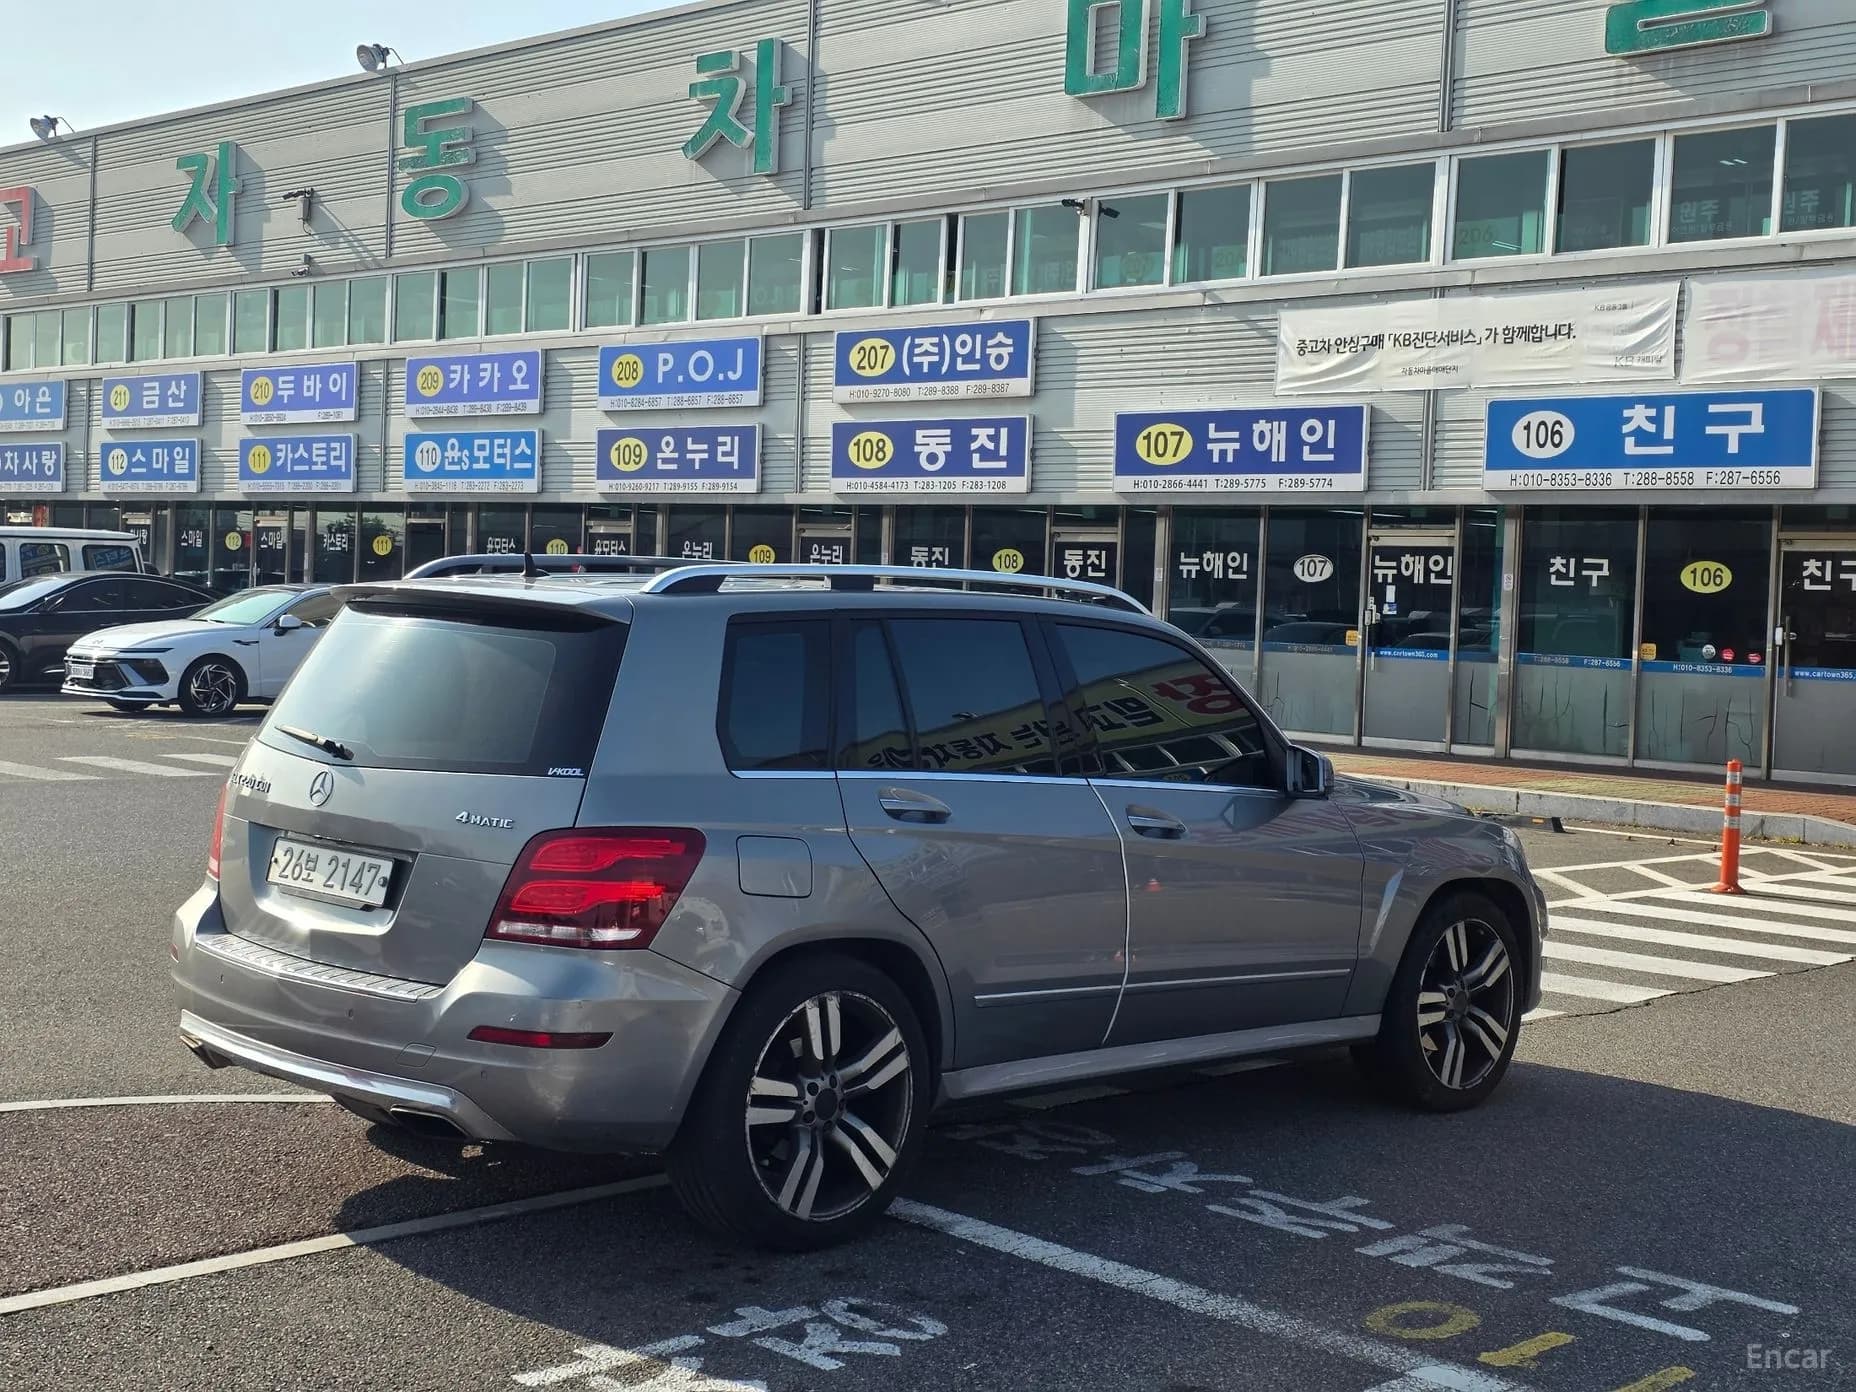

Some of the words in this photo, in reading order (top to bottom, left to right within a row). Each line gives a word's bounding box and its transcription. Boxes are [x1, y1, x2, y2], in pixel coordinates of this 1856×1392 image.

[1296, 338, 1332, 356] 중고차
[1335, 333, 1384, 354] 안심구매
[1485, 327, 1498, 344] 가
[1503, 322, 1576, 344] 함께합니다.
[617, 361, 638, 381] 208
[657, 348, 743, 383] P.O.J
[856, 344, 890, 370] 207
[902, 332, 1014, 376] (주)인승
[254, 382, 269, 400] 210
[277, 372, 347, 404] 두바이
[420, 372, 439, 390] 209
[449, 359, 530, 394] 카카오
[114, 389, 128, 403] 211
[142, 379, 187, 409] 금산
[849, 388, 911, 399] H:010-9270-8080
[918, 385, 959, 396] T:289-8388
[966, 383, 1010, 394] F:289-8387
[1142, 430, 1185, 459] 107
[1207, 418, 1335, 463] 뉴해인
[1523, 420, 1564, 450] 106
[1621, 402, 1765, 455] 친구
[4, 450, 57, 476] 차사랑
[111, 454, 125, 470] 112
[131, 446, 190, 474] 스마일
[252, 451, 267, 469] 111
[276, 442, 346, 472] 카스토리
[419, 447, 437, 466] 110
[615, 444, 643, 466] 109
[656, 435, 739, 470] 온누리
[853, 438, 887, 463] 108
[914, 427, 1008, 472] 동진
[846, 481, 908, 491] H:010-4584-4173
[913, 481, 957, 490] T:283-1205
[961, 480, 1007, 490] F:283-1208
[1133, 479, 1208, 489] H:010-2866-4441
[1215, 479, 1266, 489] T:289-5775
[1278, 478, 1333, 488] F:289-5774
[1510, 472, 1612, 487] H:010-8353-8336
[1624, 472, 1695, 486] T:288-8558
[1706, 471, 1781, 485] F:287-6556
[181, 530, 203, 547] 스마일
[260, 531, 283, 549] 스마일
[323, 533, 348, 551] 카스토리
[753, 550, 771, 563] 109
[998, 554, 1018, 569] 108
[1063, 549, 1106, 578] 동진
[1179, 551, 1248, 580] 뉴해인
[1299, 559, 1326, 577] 107
[1373, 553, 1453, 584] 뉴해인
[1549, 556, 1610, 587] 친구
[1690, 567, 1724, 587] 106
[547, 767, 585, 776] V-KOOL
[455, 811, 514, 829] 4MATIC
[278, 846, 319, 882] 26보
[323, 855, 382, 896] 2147
